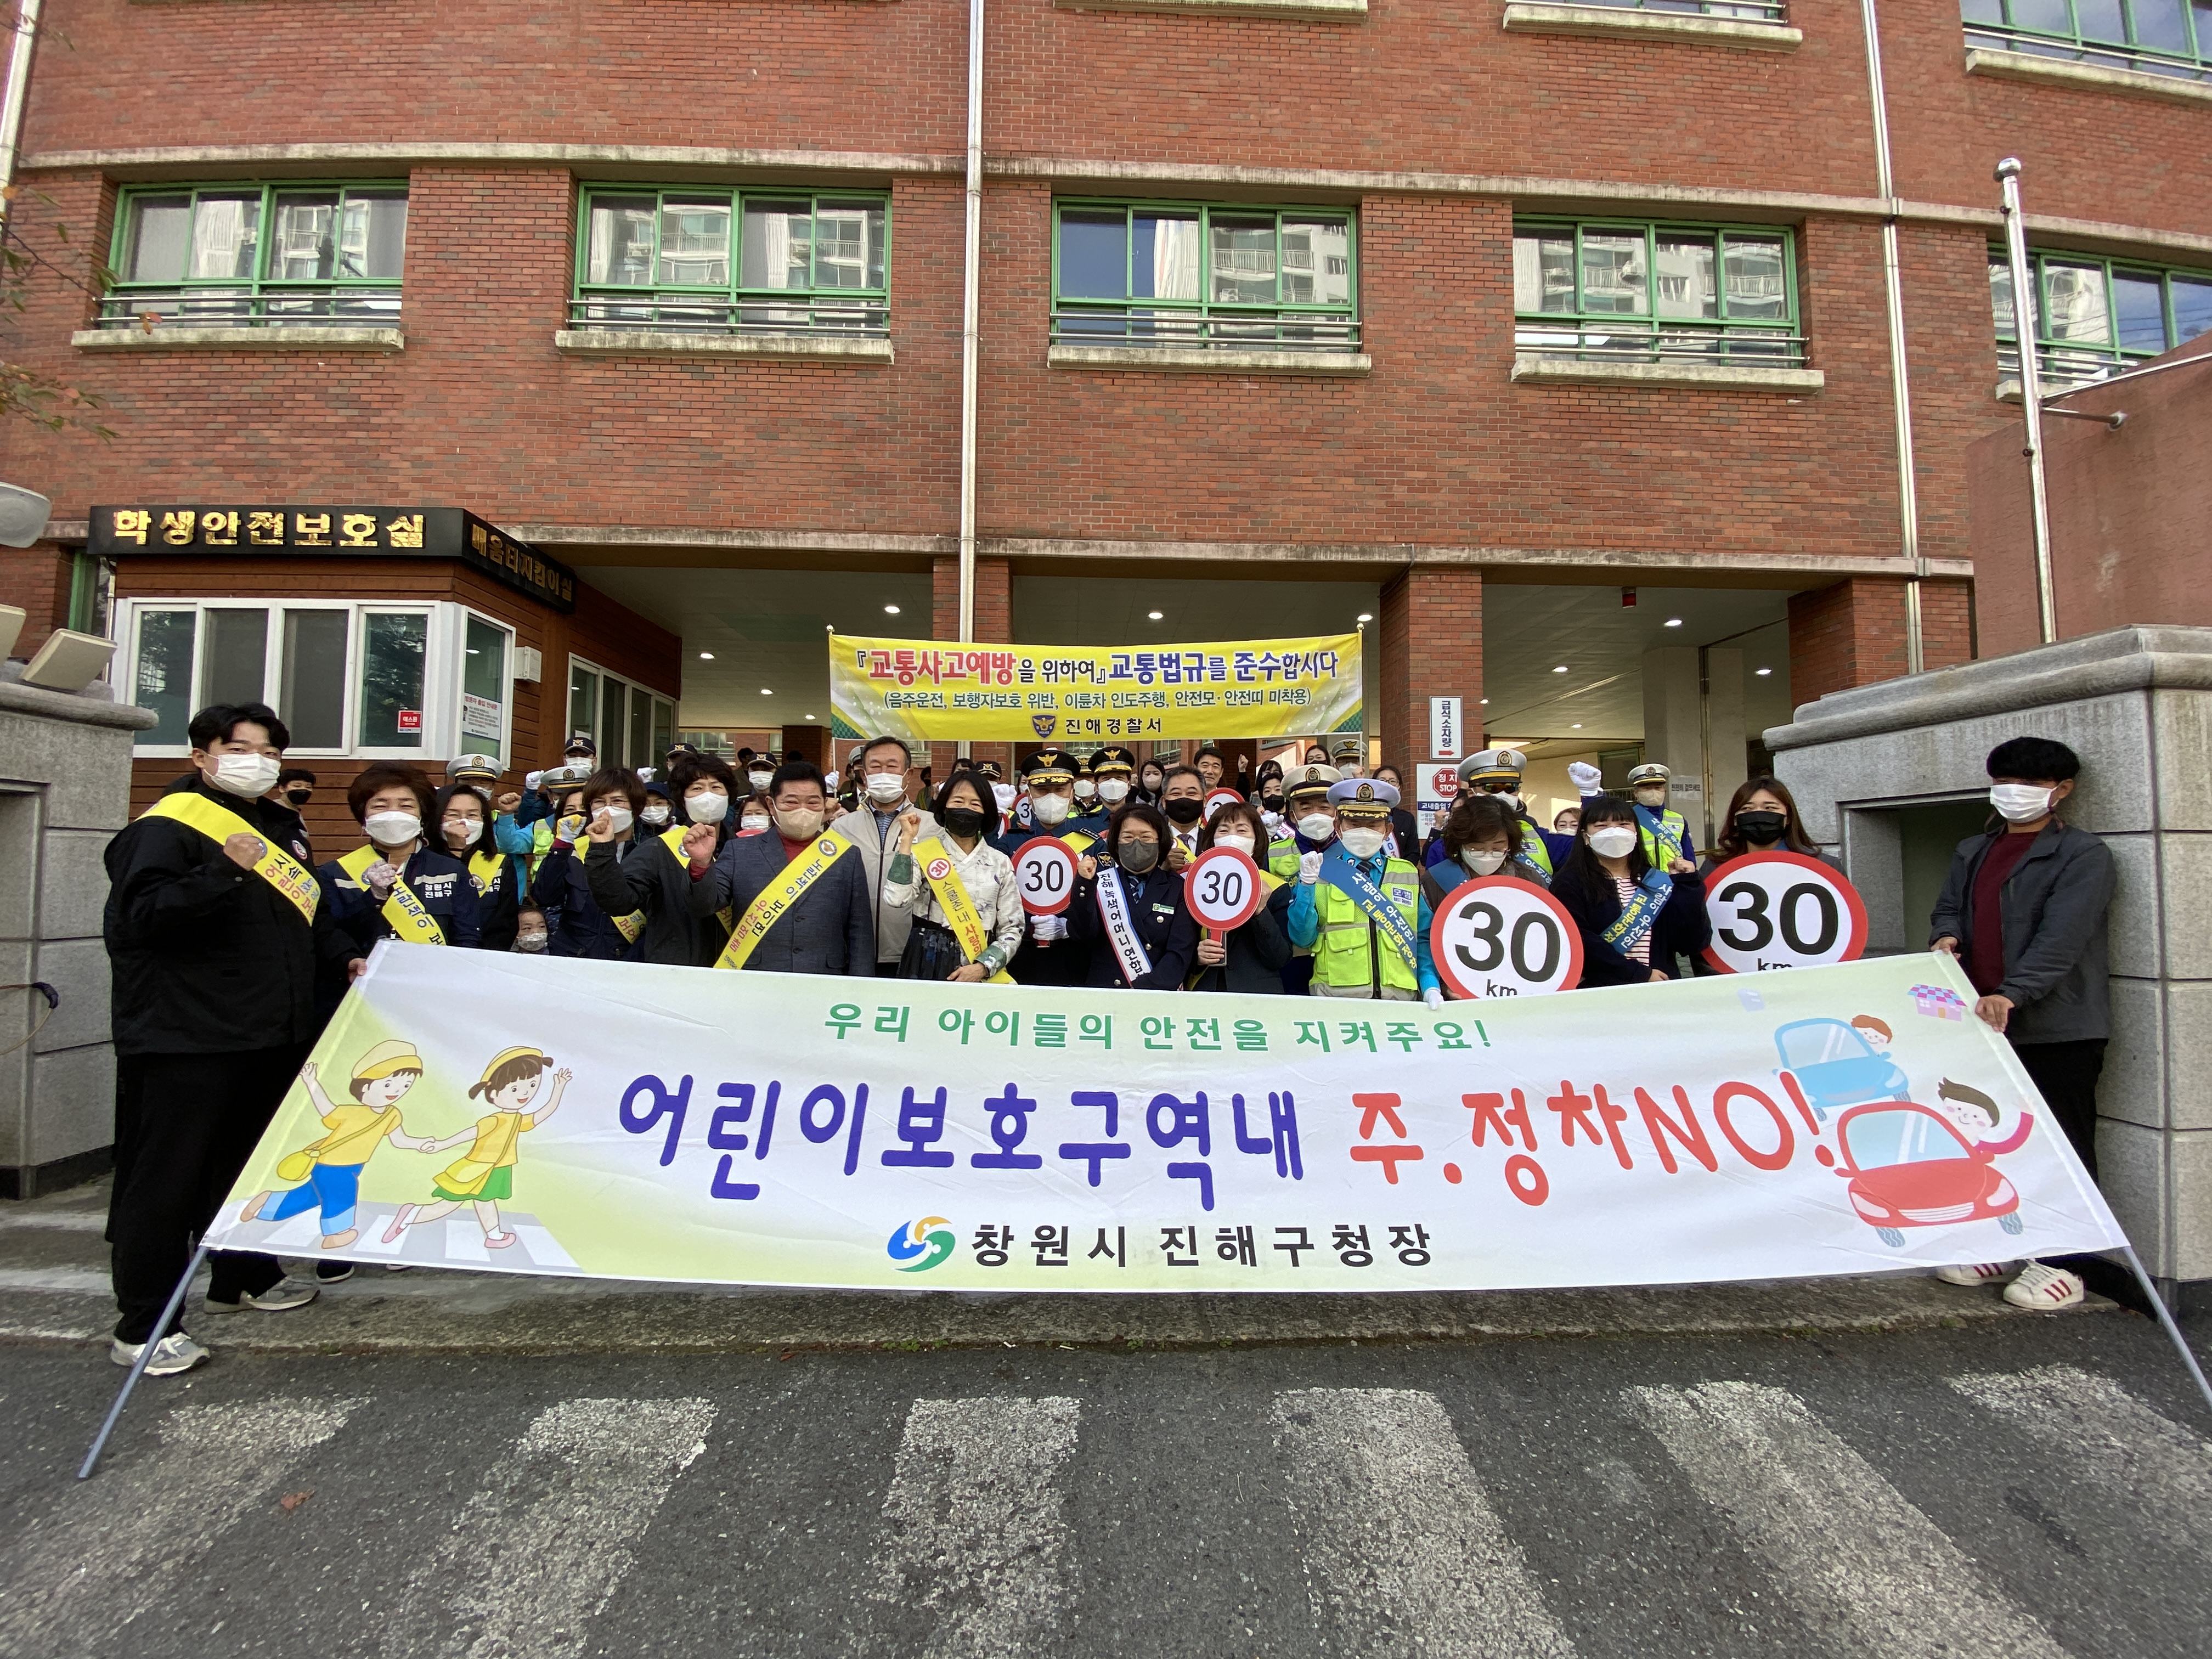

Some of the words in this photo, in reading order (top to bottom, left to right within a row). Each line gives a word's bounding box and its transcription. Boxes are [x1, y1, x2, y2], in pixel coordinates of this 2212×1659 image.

[113, 510, 424, 548] 학생안전보호실
[471, 523, 572, 602] 배움터지킴이실
[1109, 653, 1227, 685] 교통법규를
[1234, 651, 1338, 681] 준수합시다
[884, 691, 947, 709] (음주운전,
[953, 692, 1022, 709] 보행자보호
[1028, 692, 1059, 710] 위반,
[1065, 692, 1106, 709] 이륜차
[1111, 691, 1169, 709] 인도주행,
[1269, 687, 1311, 706] 미착용)
[1065, 717, 1162, 735] 진해경찰서
[1441, 700, 1452, 748] 급식소차량
[1440, 784, 1457, 792] STOP
[265, 864, 306, 900] 어린이
[425, 882, 452, 891] 창원시
[786, 859, 823, 900] 노란색이
[931, 861, 948, 876] 30
[1025, 860, 1064, 893] 30
[425, 890, 452, 899] 진해구
[1200, 870, 1243, 906] 30
[1352, 871, 1387, 903] 사람이
[1386, 906, 1415, 941] 우선인
[1652, 883, 1674, 915] 사람이
[752, 900, 785, 937] 보이면
[957, 911, 971, 923] 내
[1621, 915, 1652, 949] 우선인
[1718, 882, 1838, 956] 30
[1455, 901, 1560, 983] 30
[1486, 979, 1518, 997] km
[826, 1005, 909, 1041] 우리
[939, 1010, 1110, 1048] 아이들의
[1141, 1018, 1267, 1050] 안전을
[1296, 1021, 1487, 1052] 지켜주요!
[620, 1075, 1302, 1211] 어린이보호구역내
[972, 1225, 1125, 1267] 창원시
[1160, 1224, 1430, 1267] 진해구청장
